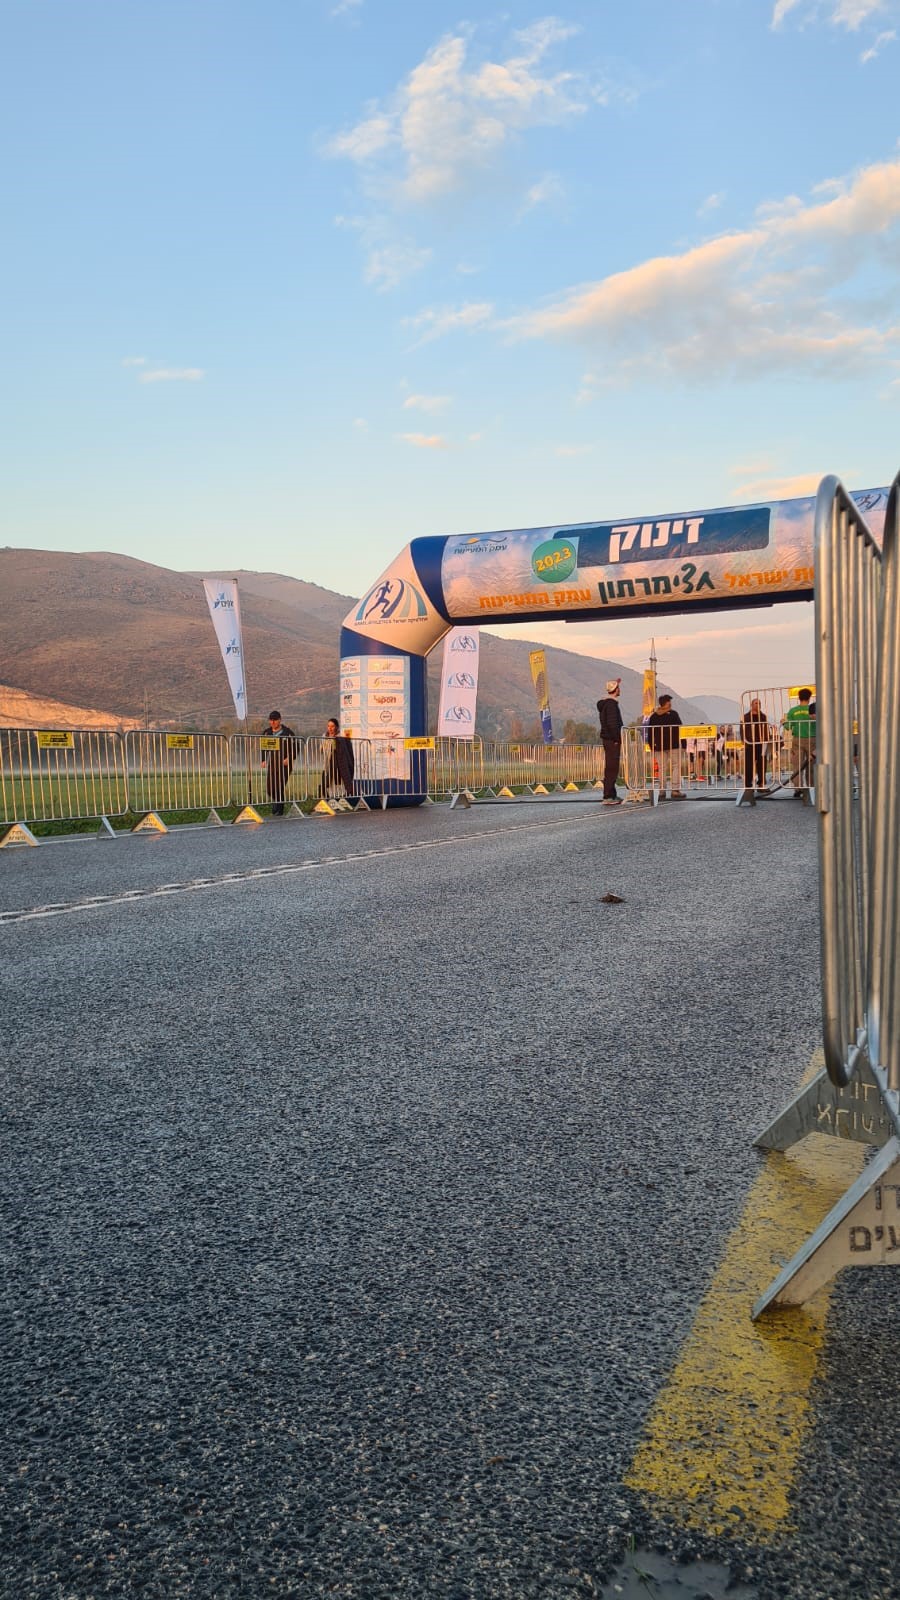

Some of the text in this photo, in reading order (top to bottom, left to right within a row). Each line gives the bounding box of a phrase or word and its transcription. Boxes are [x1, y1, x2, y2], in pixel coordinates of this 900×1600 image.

[608, 517, 705, 563] זינוק
[535, 547, 572, 572] 2023
[723, 569, 789, 588] ישראל
[479, 588, 592, 609] עמק המעיינות
